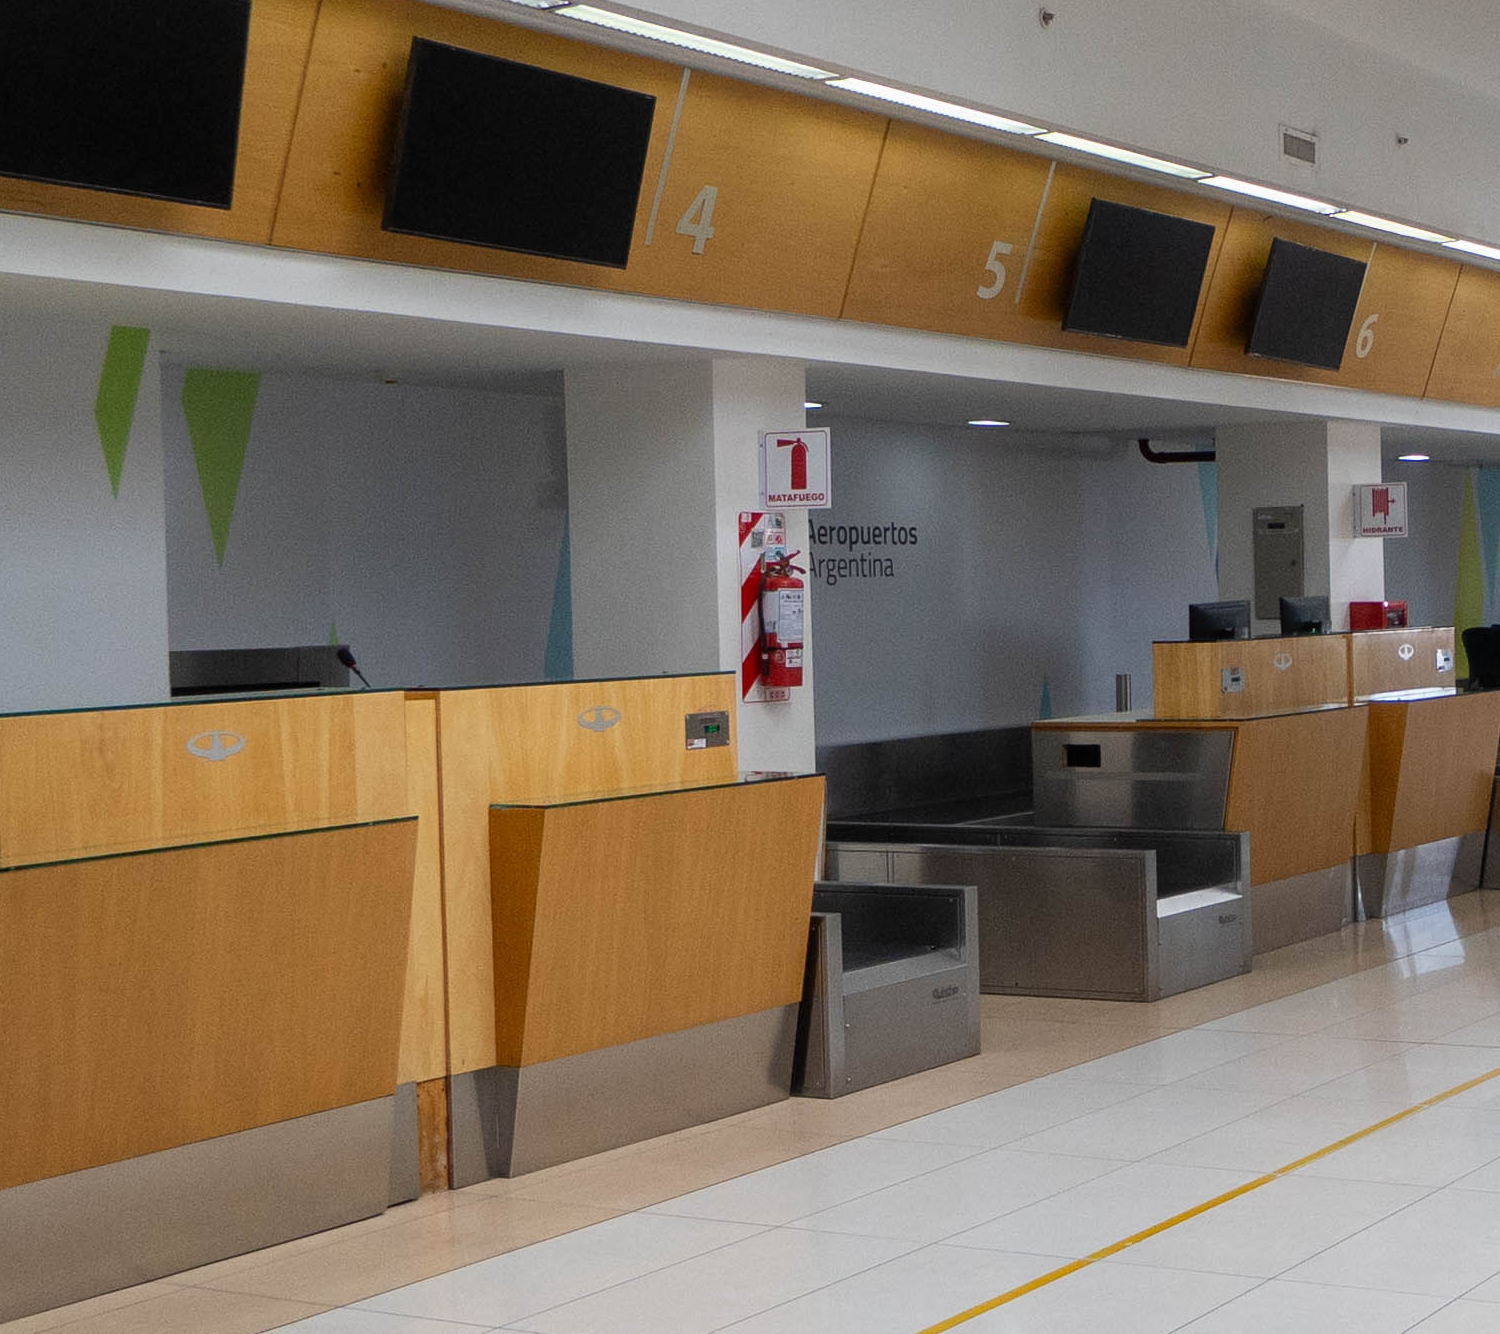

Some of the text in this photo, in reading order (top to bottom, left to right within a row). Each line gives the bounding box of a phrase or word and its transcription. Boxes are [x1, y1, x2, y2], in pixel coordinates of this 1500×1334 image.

[675, 185, 718, 255] 4
[976, 240, 1013, 300] 5
[1355, 313, 1379, 359] 6
[768, 493, 825, 502] MATAFUEGO
[808, 519, 918, 551] Aeropuertos
[1363, 526, 1403, 534] HIDRANTE
[809, 551, 895, 586] Argentina
